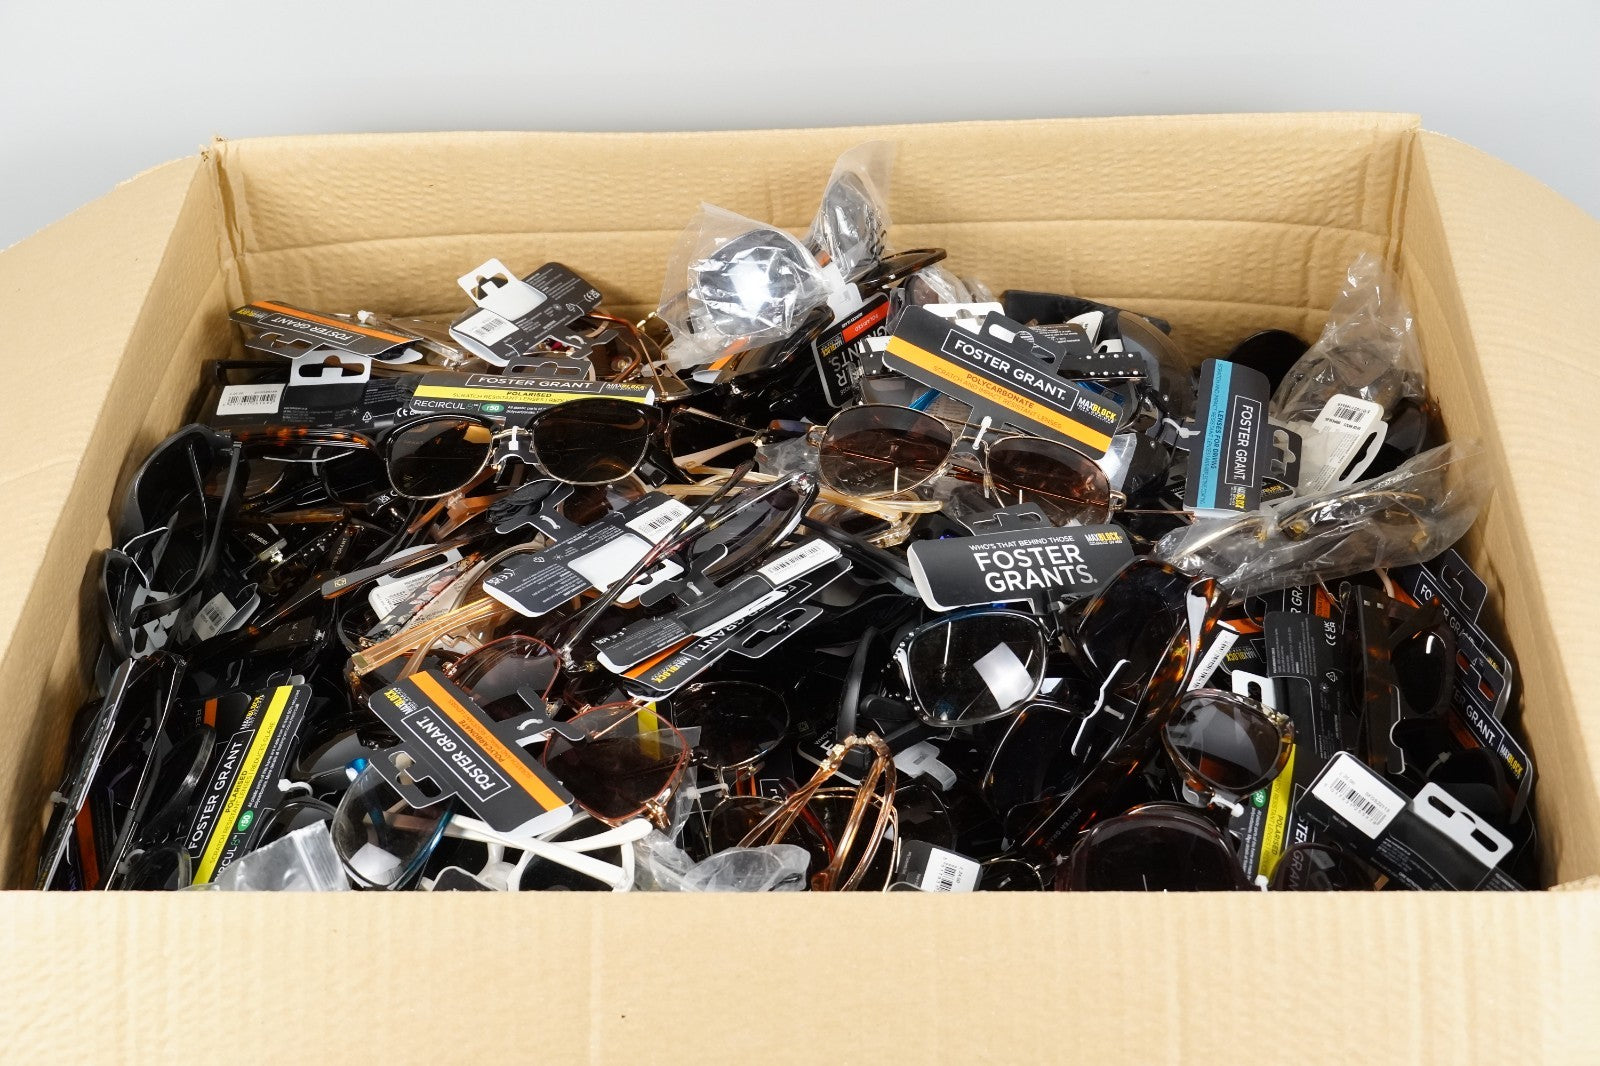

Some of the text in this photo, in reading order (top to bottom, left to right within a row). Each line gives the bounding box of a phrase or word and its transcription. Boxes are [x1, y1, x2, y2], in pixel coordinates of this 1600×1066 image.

[271, 316, 352, 341] FOSTER GRANT
[954, 339, 1010, 373] FOSTER
[478, 377, 593, 390] FOSTER GRANT
[966, 373, 1034, 408] POLYCARBONATE
[1077, 397, 1117, 420] MAXBLOCK
[1237, 404, 1253, 447] FOSTER
[968, 535, 1075, 551] WHO'S THAT BEHIND THOSE
[1084, 531, 1119, 542] MAXBLOCK
[973, 544, 1085, 572] FOSTER
[985, 564, 1098, 593] GRANTS.
[654, 656, 692, 684] MAXBLOCK
[384, 689, 413, 715] MAXBLOCK
[459, 719, 504, 763] POLYCARBONATE
[452, 750, 496, 791] FOSTER
[1500, 743, 1523, 776] MAXBLOCK
[188, 741, 243, 850] FOSTER GRANT
[224, 770, 248, 813] POLARISED
[210, 834, 226, 863] SCRATCH
[221, 799, 240, 835] RESISTANT
[241, 814, 251, 827] r50
[1272, 815, 1284, 856] POLARISED
